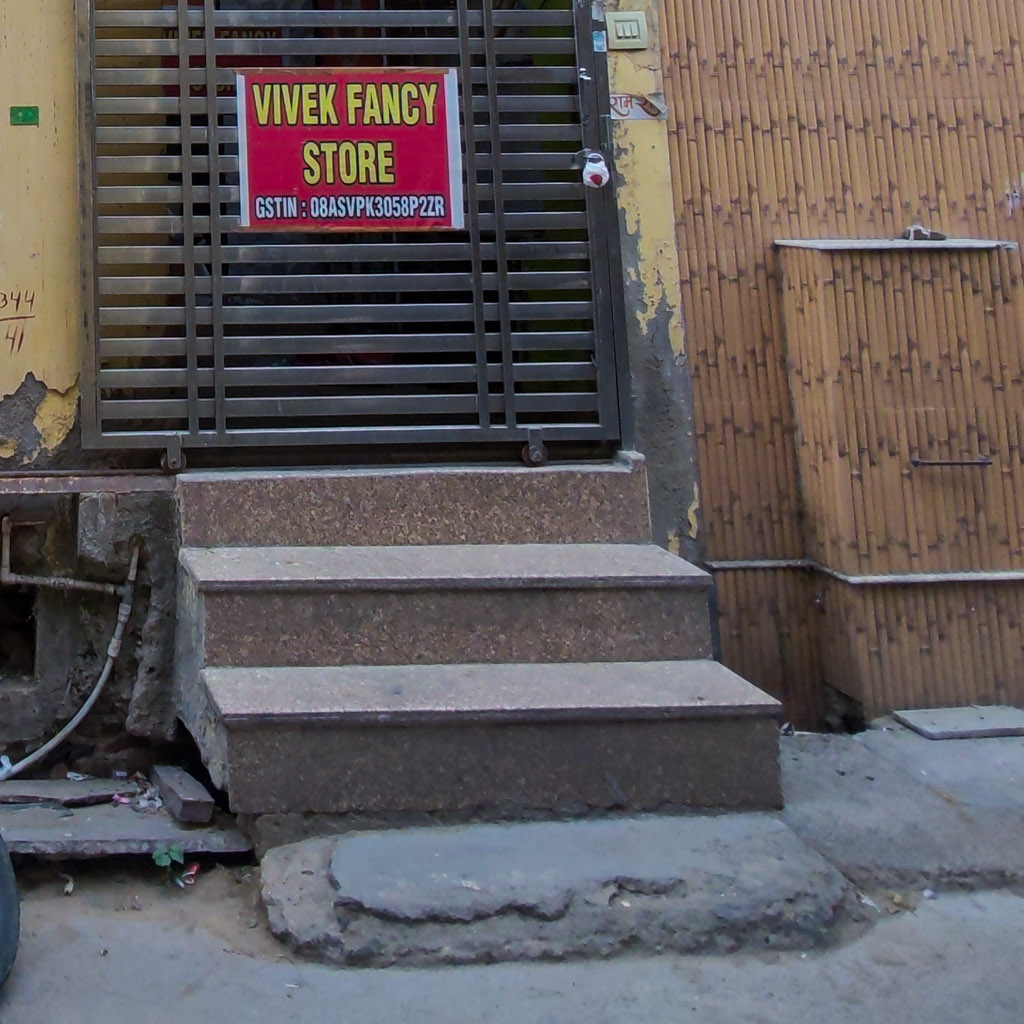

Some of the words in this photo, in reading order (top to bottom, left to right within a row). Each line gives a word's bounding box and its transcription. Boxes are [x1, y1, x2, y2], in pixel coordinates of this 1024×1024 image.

[251, 83, 339, 126] VIVEK
[345, 82, 439, 126] FANCY
[302, 141, 396, 186] STORE
[255, 195, 298, 219] GSTIN
[310, 195, 446, 218] 08ASVPK3058P2ZR
[5, 324, 24, 355] 41
